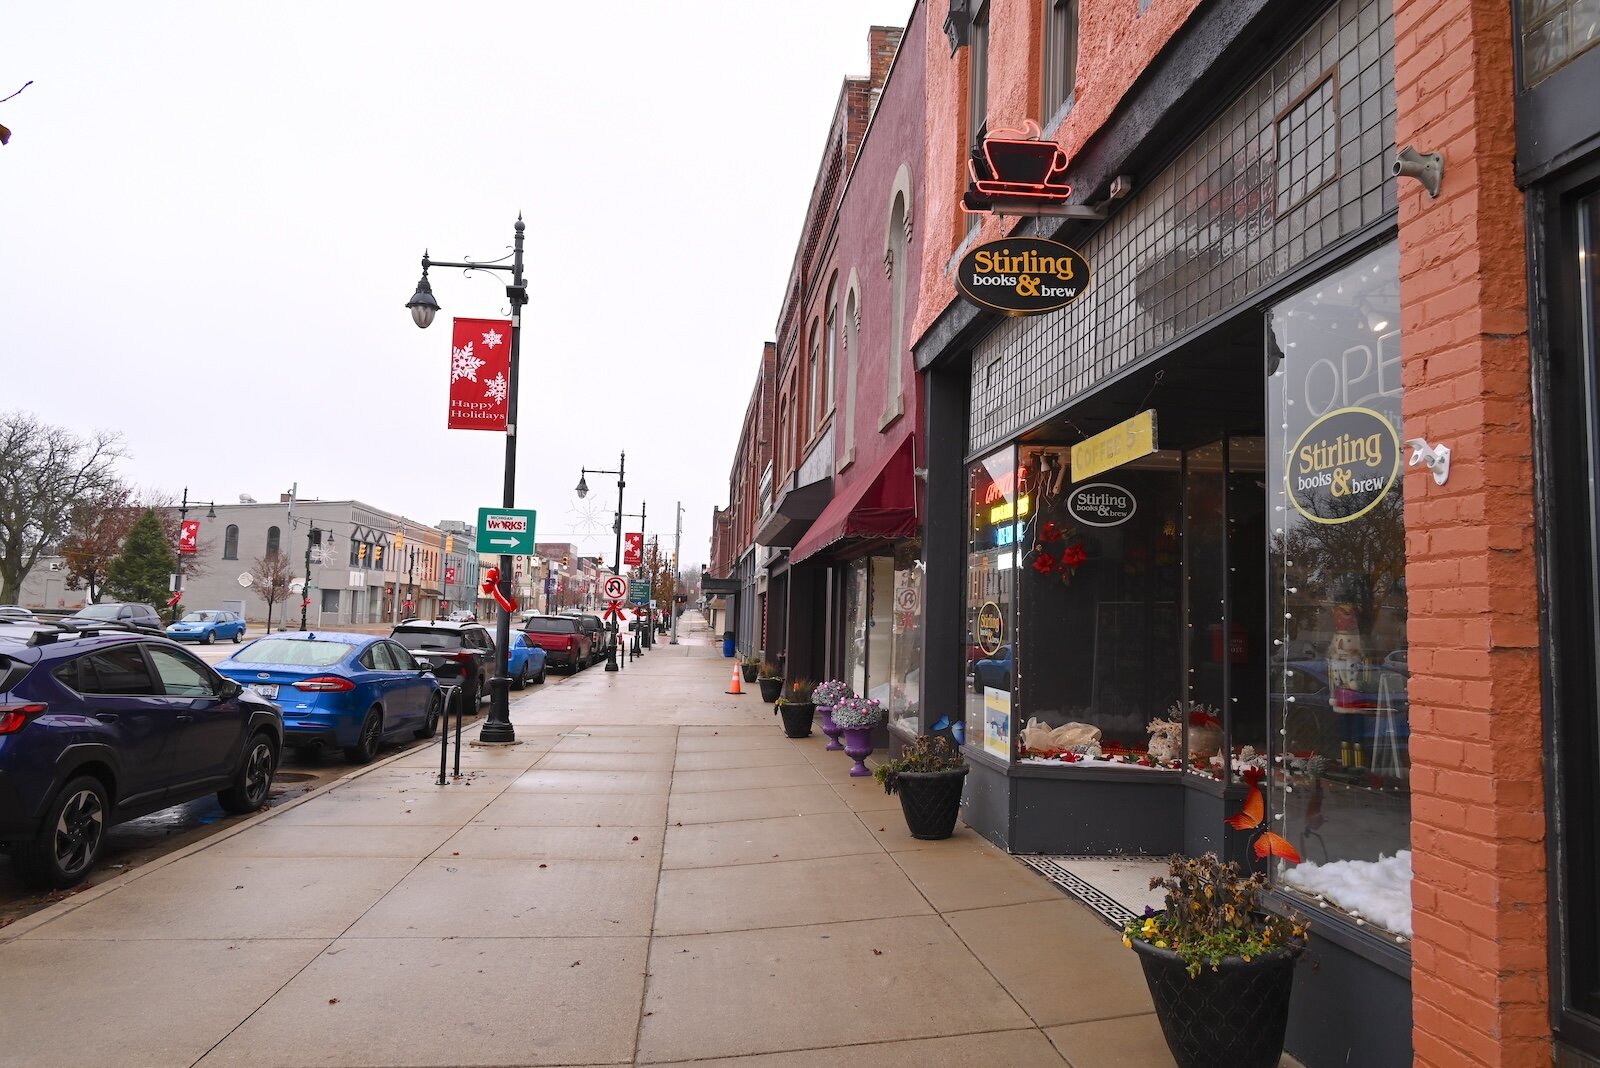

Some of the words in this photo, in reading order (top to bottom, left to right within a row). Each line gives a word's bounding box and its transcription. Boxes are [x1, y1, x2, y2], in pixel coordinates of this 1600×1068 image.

[975, 249, 1074, 281] Stirling
[973, 274, 1017, 286] books
[1016, 274, 1041, 297] &
[1041, 285, 1076, 297] brew
[1304, 329, 1402, 417] OPE
[451, 400, 494, 410] Happy
[451, 410, 505, 421] Holidays
[1299, 433, 1382, 474] Stirling
[1298, 472, 1332, 491] books
[1331, 467, 1352, 497] &
[1352, 476, 1384, 494] brew
[1077, 493, 1126, 508] Stirling
[1077, 504, 1098, 512] books
[1097, 504, 1110, 517] &
